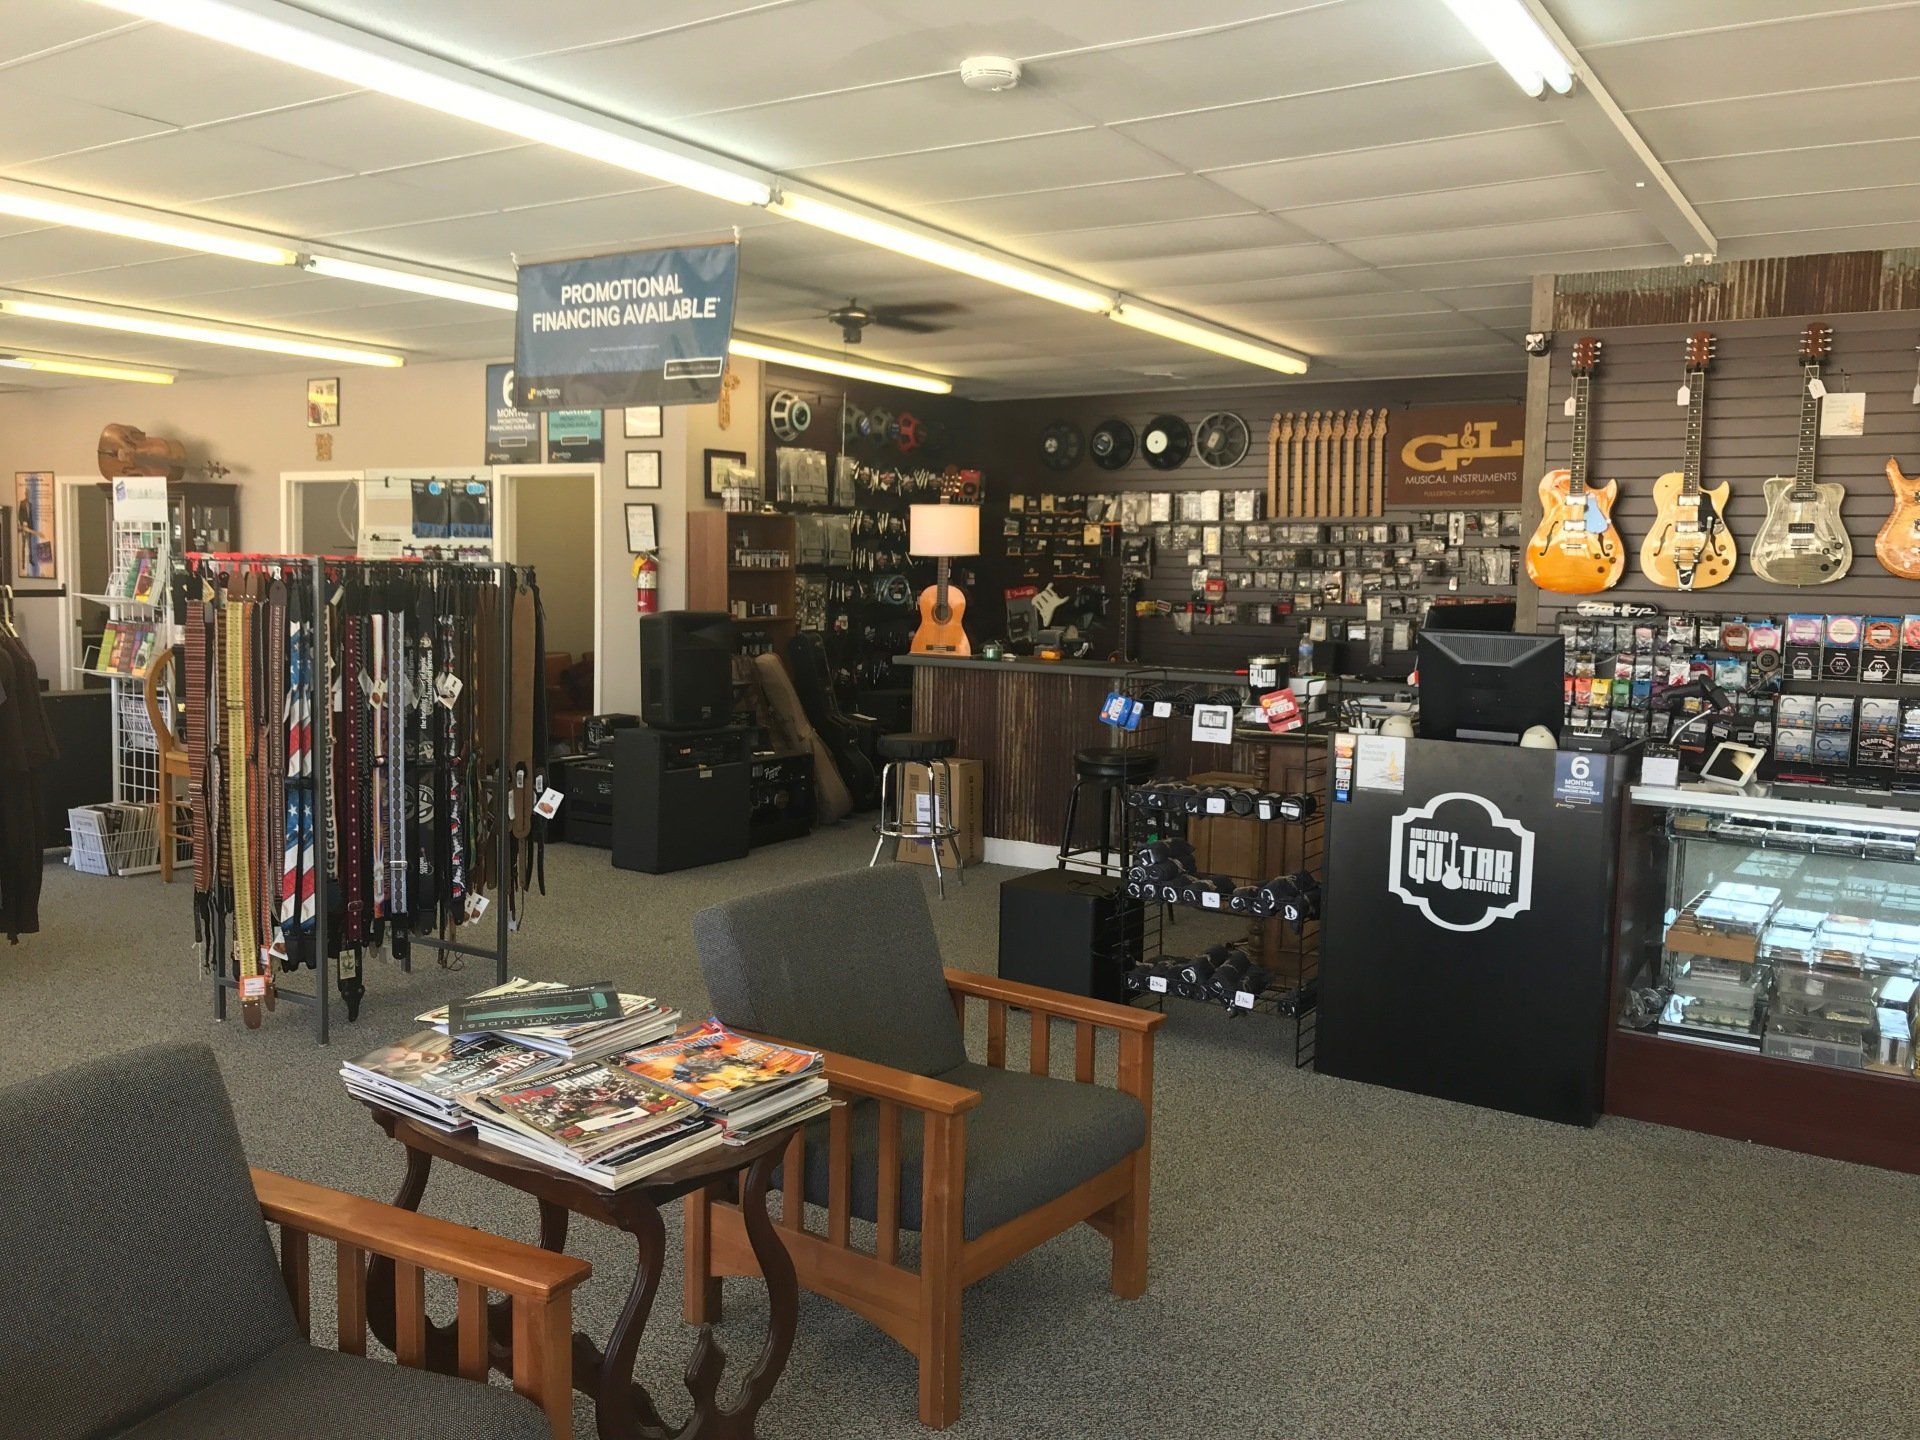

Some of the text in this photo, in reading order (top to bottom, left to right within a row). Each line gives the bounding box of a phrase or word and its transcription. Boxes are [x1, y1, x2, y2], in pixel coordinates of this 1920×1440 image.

[561, 273, 683, 306] PROMOTIONAL
[533, 304, 621, 333] FINANCING
[1405, 471, 1517, 485] MUSICAL INSTRUMENTS
[1570, 755, 1590, 780] 6
[1564, 779, 1594, 787] MONTHS
[1408, 835, 1513, 888] GUITAR
[1462, 877, 1511, 895] BOUTIQUE
[505, 1062, 598, 1092] SPECIAL COLLECTOR'S EDITION
[552, 1068, 613, 1090] Player
